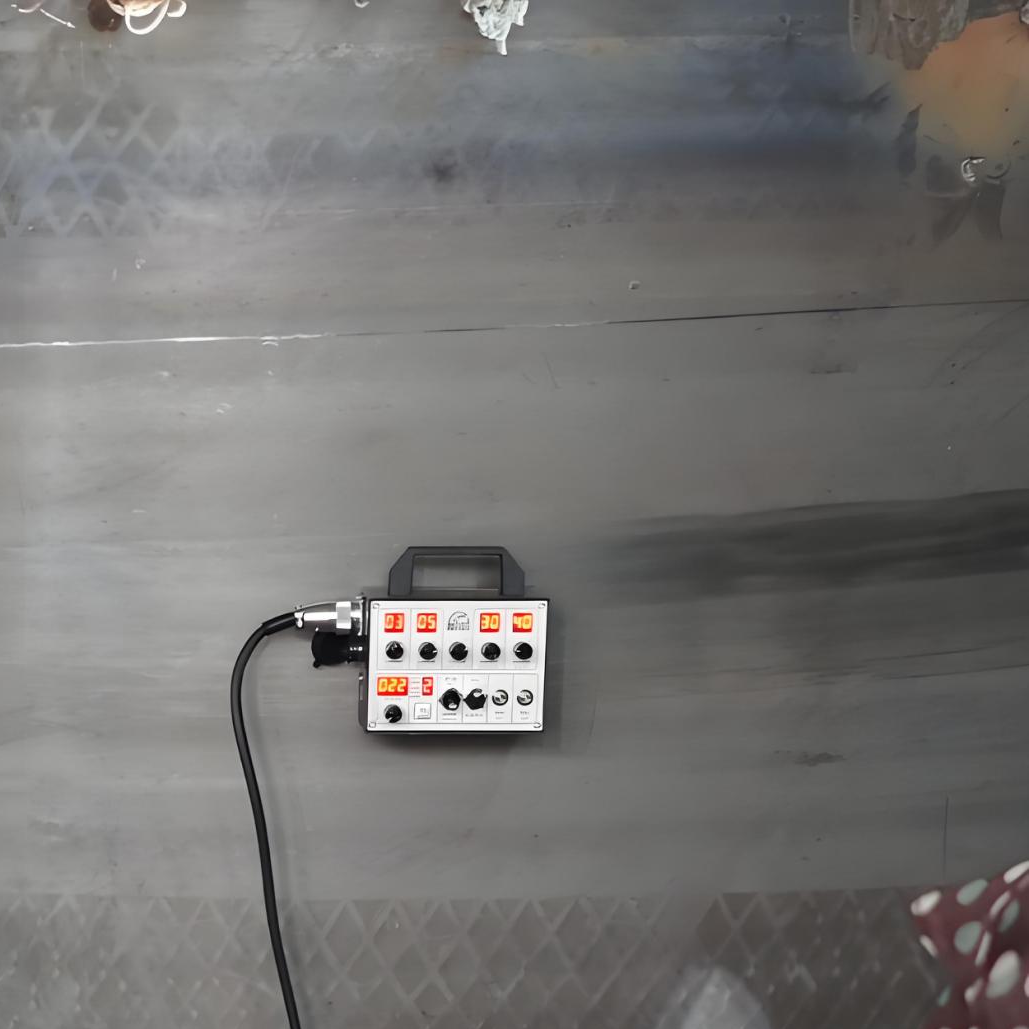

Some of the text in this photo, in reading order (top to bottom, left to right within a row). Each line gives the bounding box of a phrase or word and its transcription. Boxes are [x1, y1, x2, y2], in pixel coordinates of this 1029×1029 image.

[385, 614, 404, 631] 03
[417, 614, 436, 631] 05
[480, 613, 499, 631] 30
[512, 613, 533, 631] 40
[377, 678, 408, 693] 022
[422, 678, 433, 694] 2
